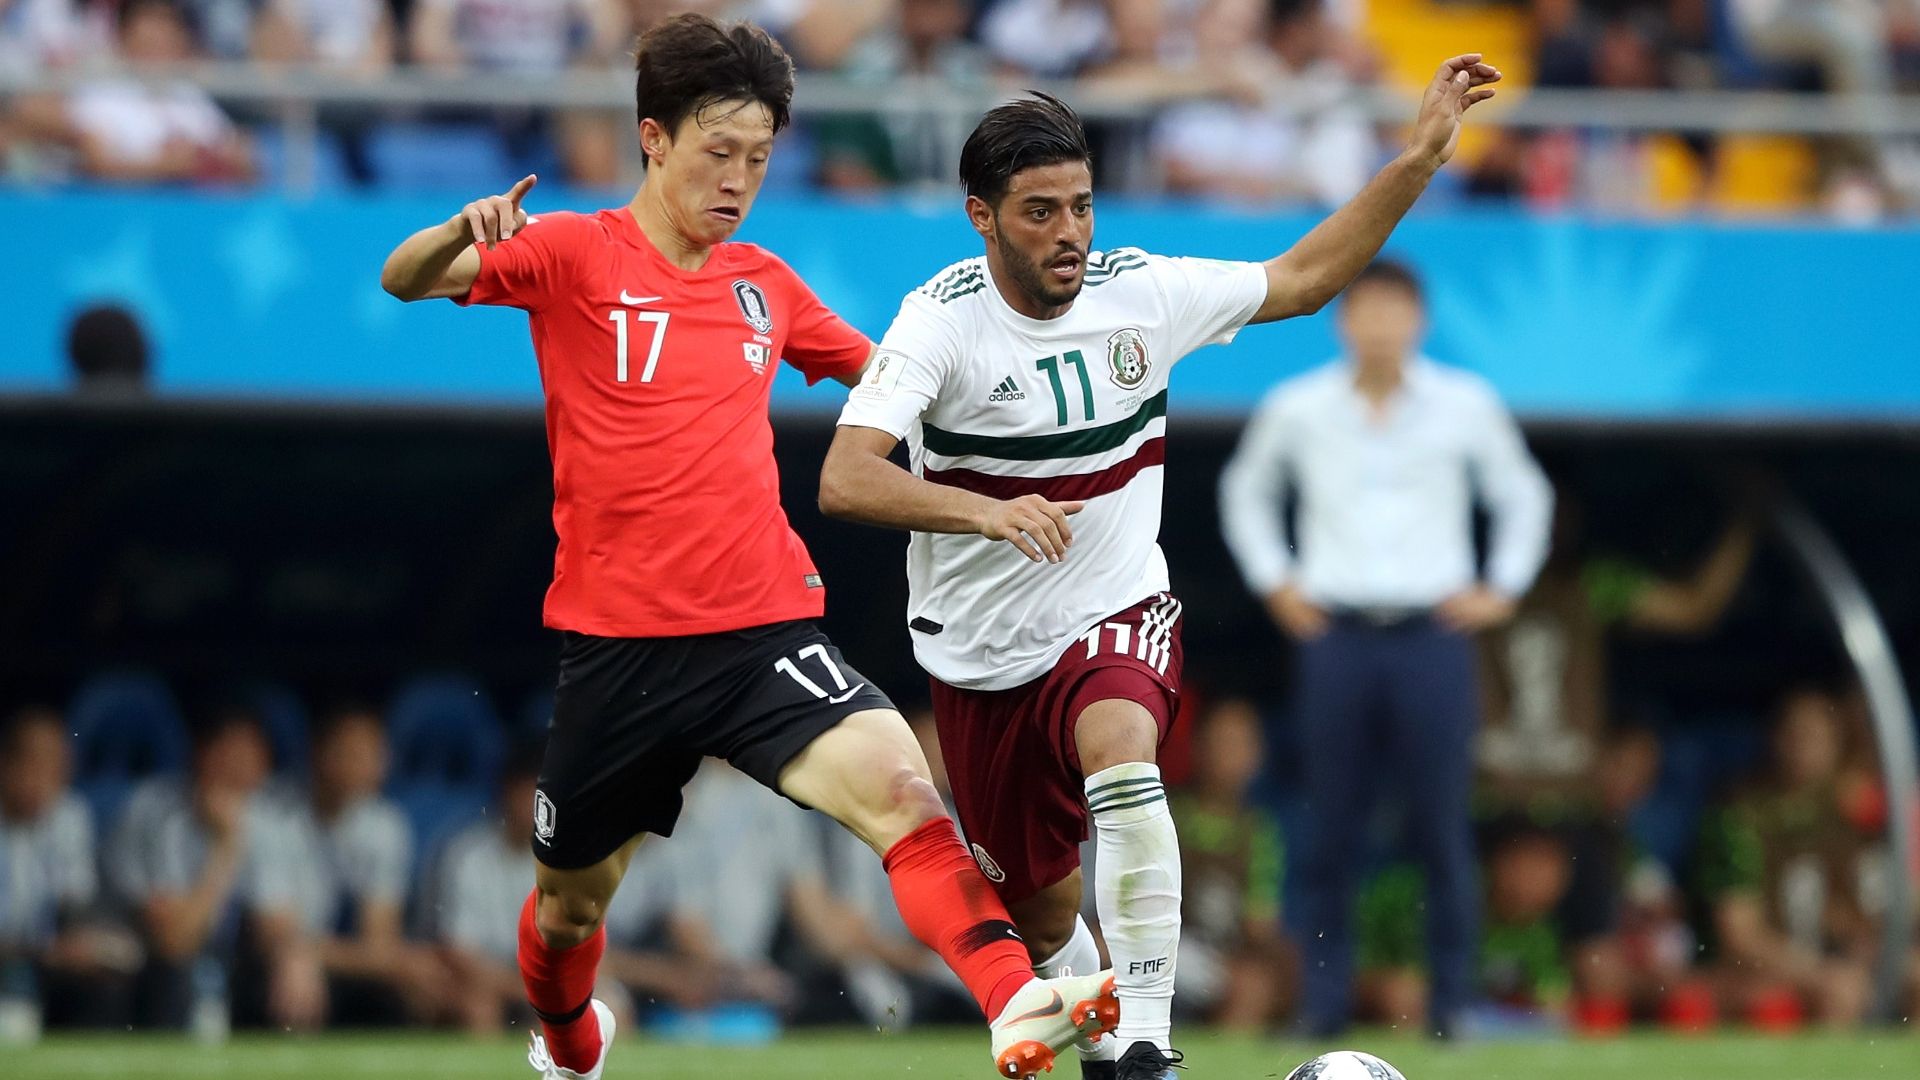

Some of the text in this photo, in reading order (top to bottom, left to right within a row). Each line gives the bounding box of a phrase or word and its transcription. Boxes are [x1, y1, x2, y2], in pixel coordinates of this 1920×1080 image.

[609, 310, 671, 383] 17
[989, 392, 1025, 402] adidas
[1036, 349, 1095, 427] 11
[1080, 622, 1131, 660] 11
[774, 643, 849, 698] 17
[1129, 957, 1168, 975] FMF
